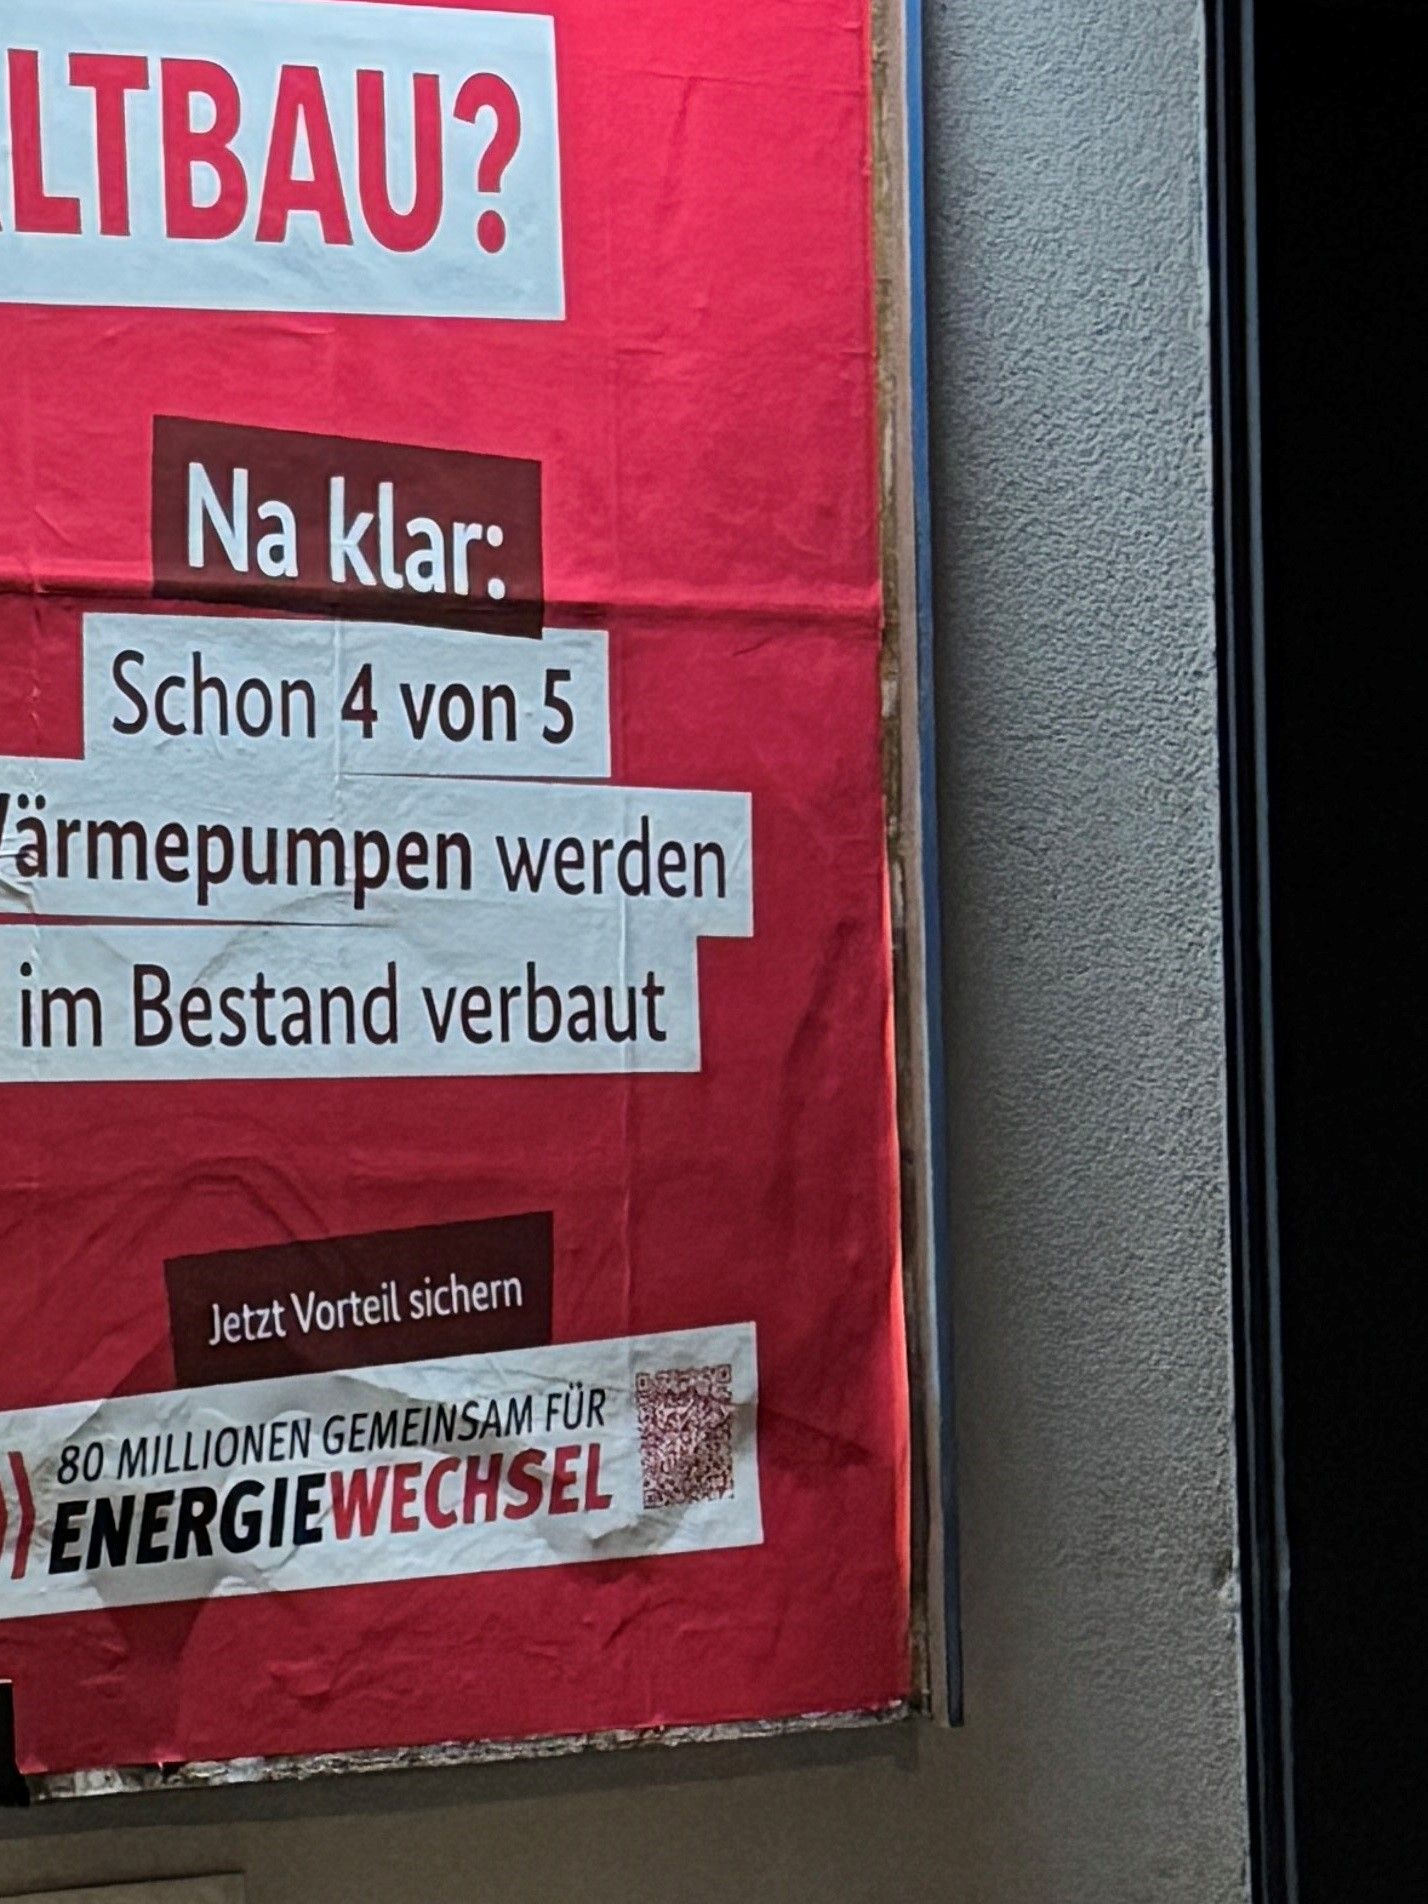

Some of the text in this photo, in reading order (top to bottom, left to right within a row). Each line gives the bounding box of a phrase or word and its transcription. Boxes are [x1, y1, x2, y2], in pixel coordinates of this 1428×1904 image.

[187, 461, 506, 601] Na klar:
[110, 649, 575, 745] Schon 4 von 5
[495, 815, 727, 899] werden
[19, 960, 667, 1048] im Bestand verbaut
[208, 1270, 523, 1346] Jetzt Vorteil sichern
[56, 1380, 607, 1484] 80 MILLIONEN GEMEINSAM FÜR
[48, 1444, 612, 1574] ENERGIEWECHSEL
